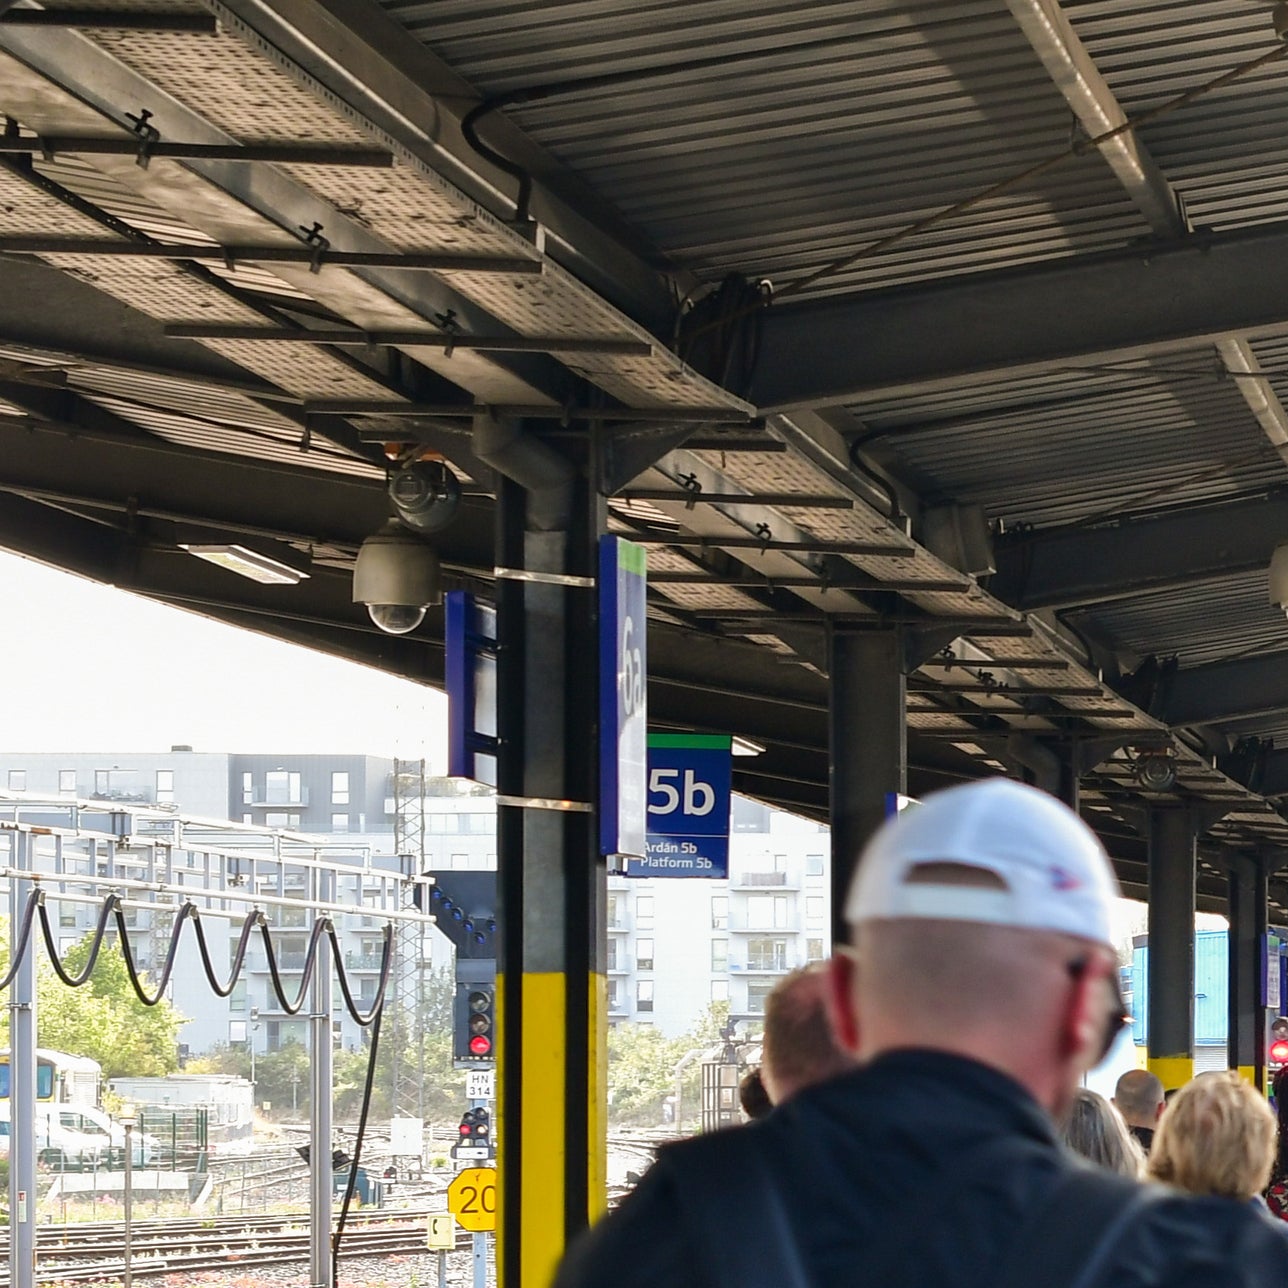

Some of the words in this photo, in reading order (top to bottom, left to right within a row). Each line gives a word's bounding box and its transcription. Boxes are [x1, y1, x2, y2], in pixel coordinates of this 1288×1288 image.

[622, 615, 642, 718] 6a
[647, 769, 716, 816] 5b
[681, 842, 698, 854] 5b
[640, 856, 693, 868] Platform
[696, 857, 713, 869] 5b
[472, 1075, 489, 1083] HN
[470, 1087, 491, 1096] 314
[460, 1185, 496, 1214] 20
